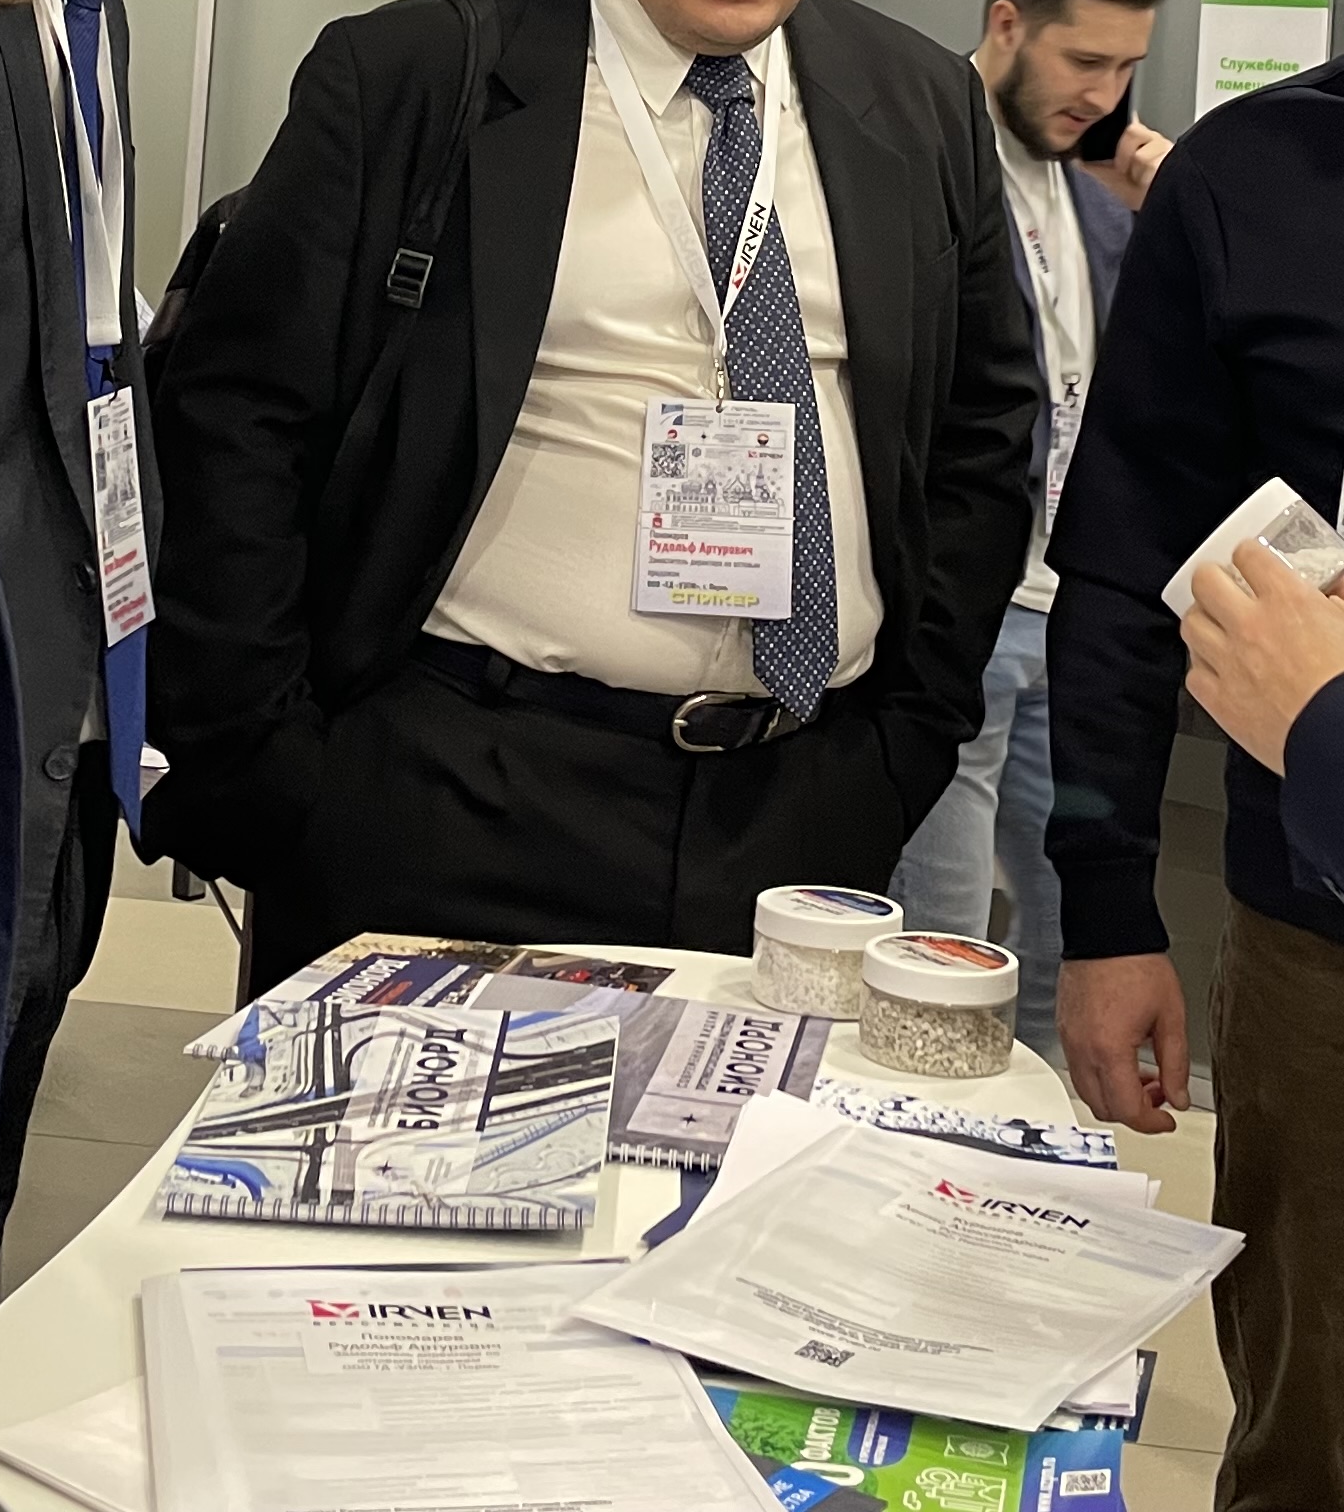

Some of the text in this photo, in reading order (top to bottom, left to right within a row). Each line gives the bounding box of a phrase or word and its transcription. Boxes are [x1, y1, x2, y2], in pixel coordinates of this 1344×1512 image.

[1220, 56, 1300, 72] Служебное
[741, 202, 766, 265] IRVEN
[649, 539, 753, 556] Рудольф Артурович
[671, 591, 760, 608] СПИКЕР
[716, 1016, 784, 1096] БИОНОРД
[397, 1028, 468, 1130] БИОНОРД
[980, 1197, 1091, 1229] IRVEN
[367, 1303, 492, 1320] IRVEN
[361, 1332, 464, 1344] Пономарев
[328, 1342, 502, 1352] Рудольф Артурович
[800, 1406, 841, 1461] ФАКТОВ
